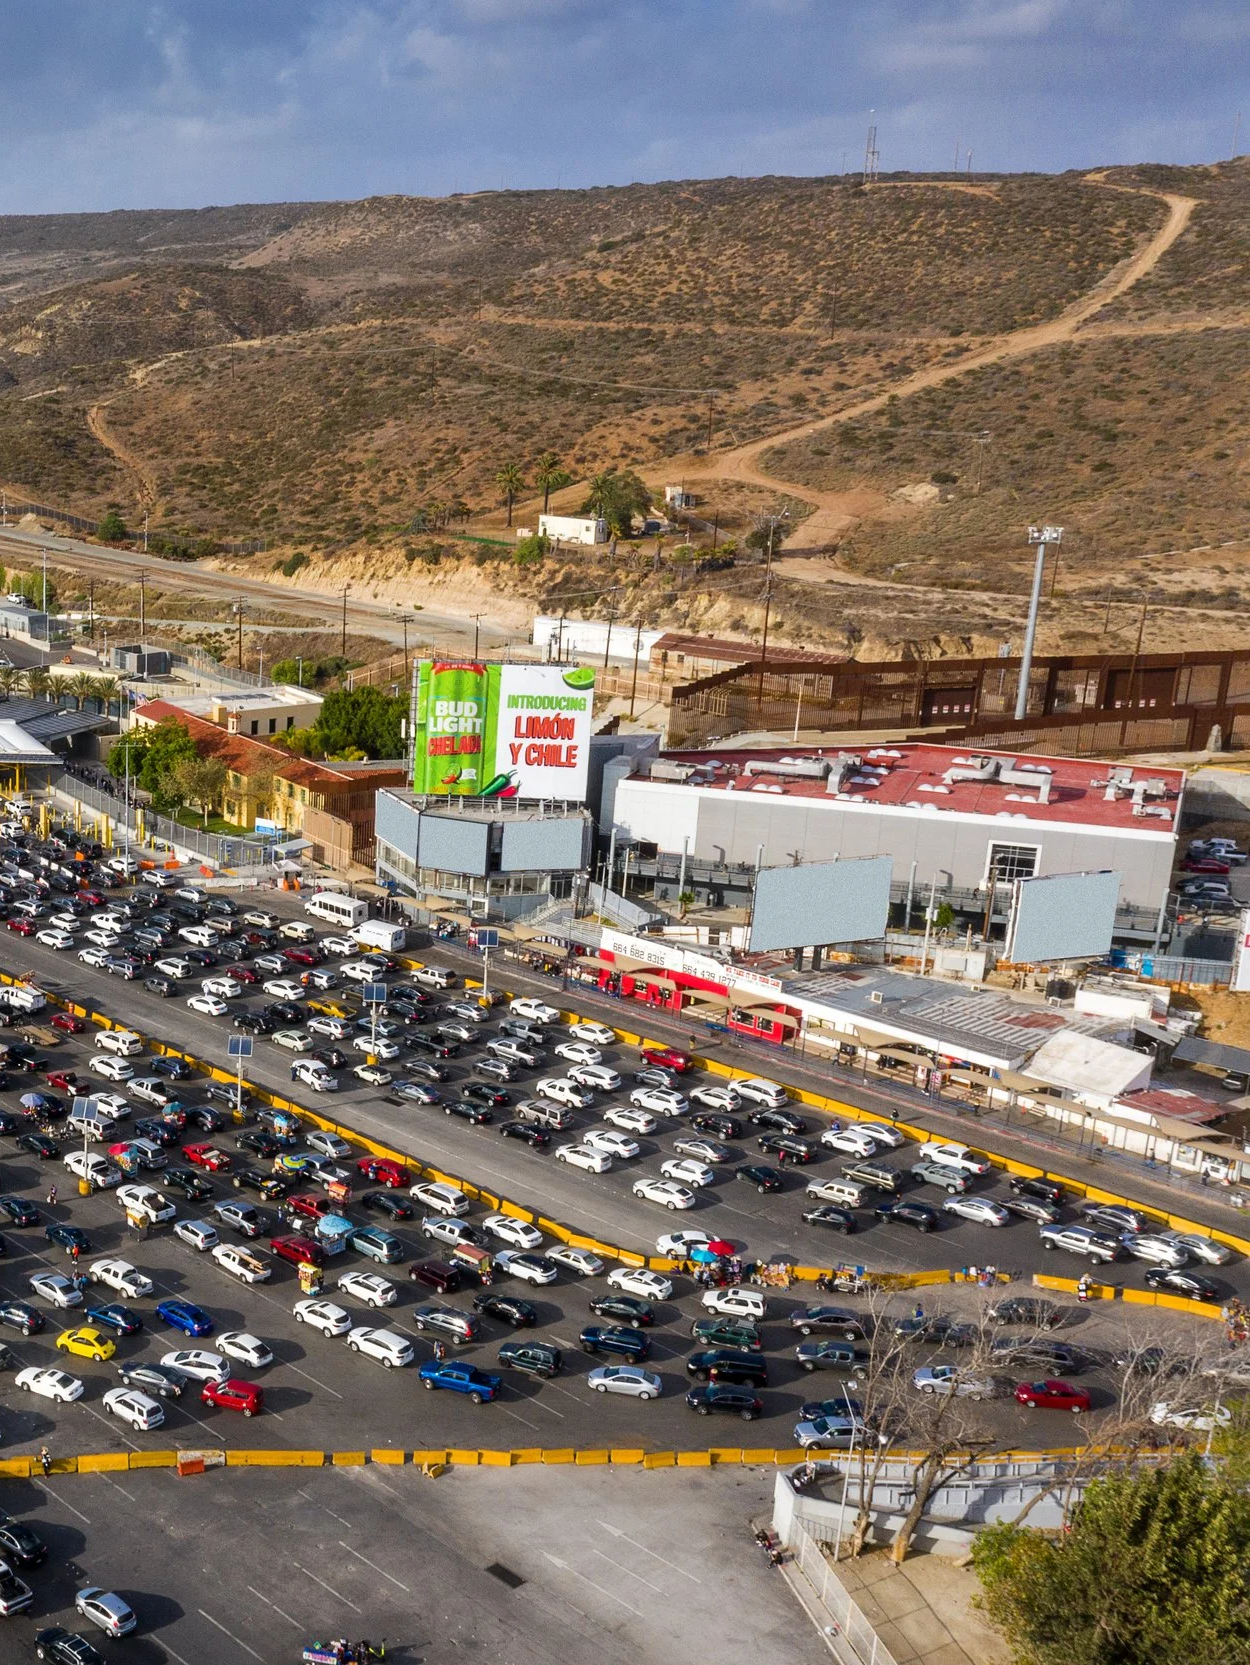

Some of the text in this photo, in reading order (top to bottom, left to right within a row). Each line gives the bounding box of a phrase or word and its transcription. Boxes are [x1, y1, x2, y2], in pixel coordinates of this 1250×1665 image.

[435, 701, 478, 717] BUD
[507, 694, 587, 711] INTRODUCING
[429, 717, 483, 733] LIGHT
[514, 713, 575, 740] LIMÓN
[509, 744, 579, 768] Y CHILE
[613, 942, 665, 965] 664 682 8315
[682, 964, 697, 976] 664
[700, 970, 716, 982] 439
[718, 975, 737, 988] 1277
